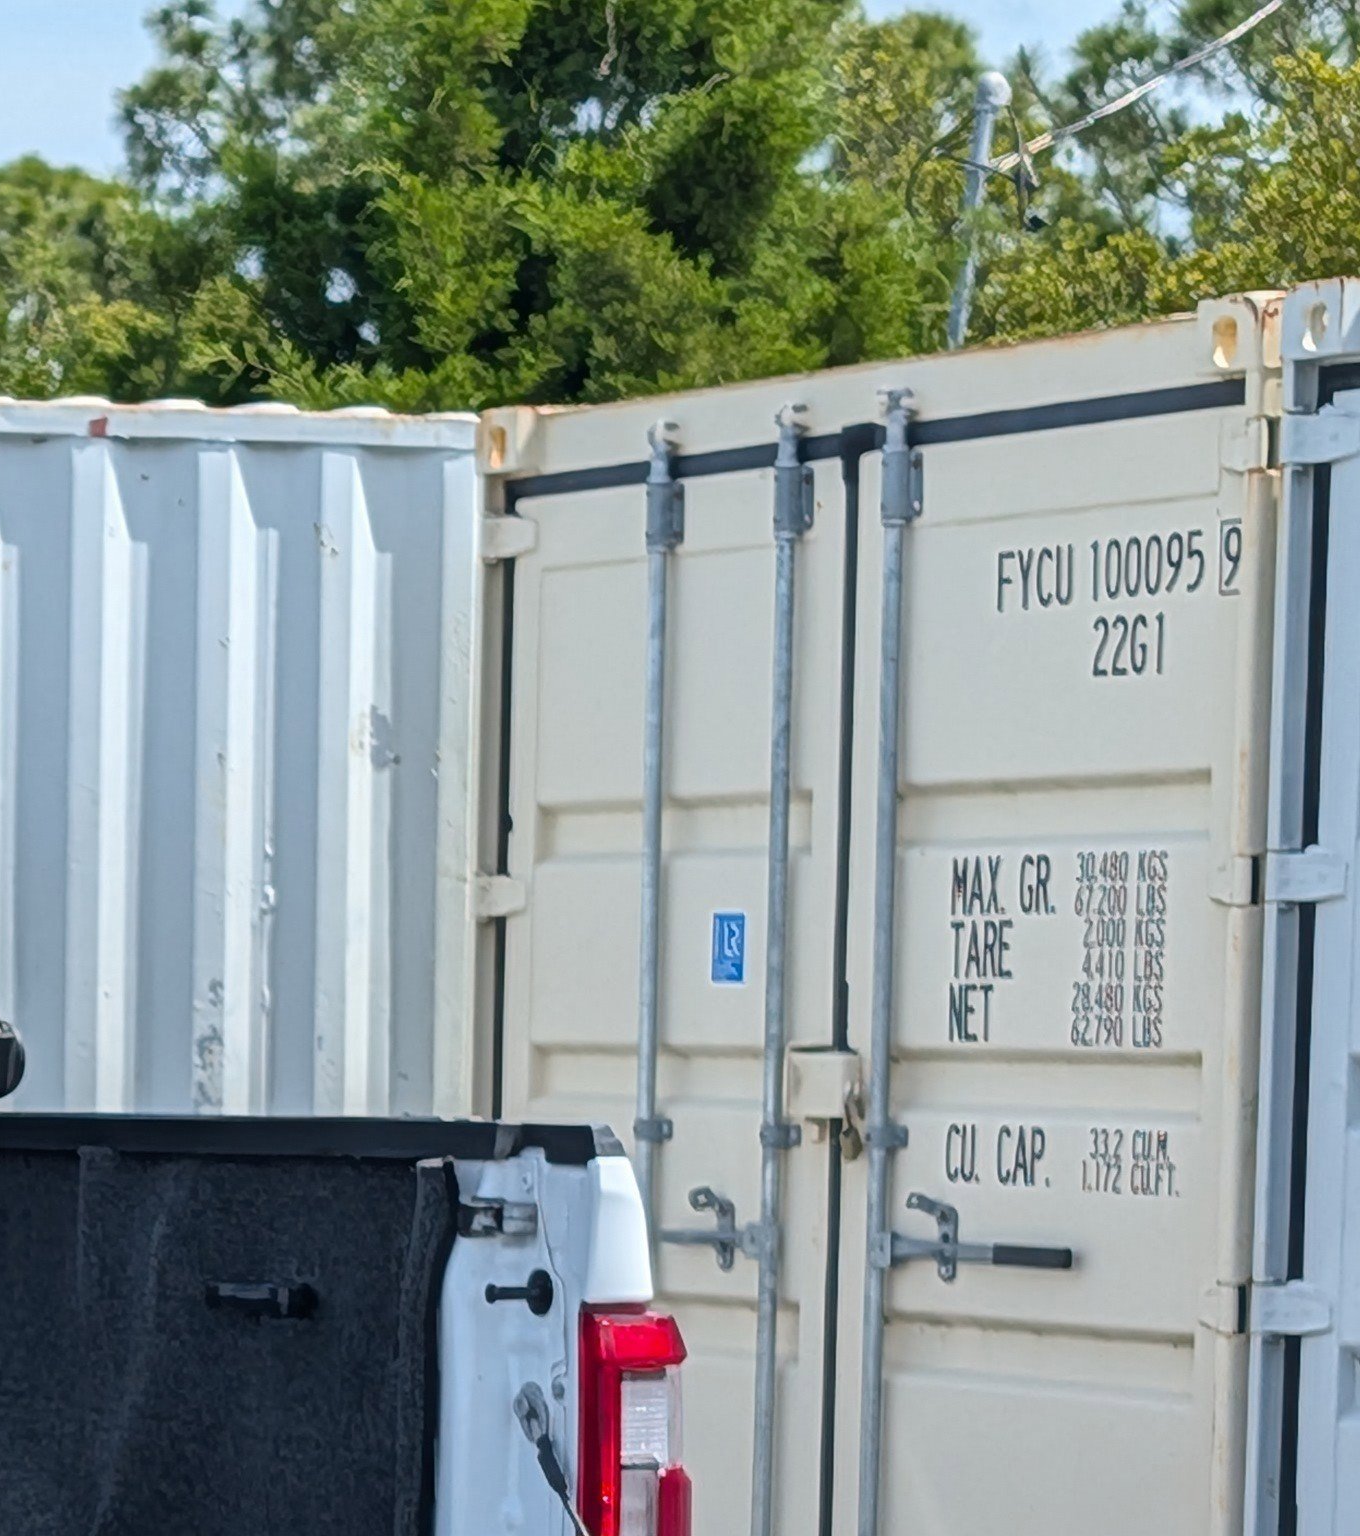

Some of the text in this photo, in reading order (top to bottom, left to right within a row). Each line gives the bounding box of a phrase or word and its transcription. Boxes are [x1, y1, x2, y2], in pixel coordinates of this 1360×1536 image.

[997, 526, 1243, 613] FYCU 100095 9
[1092, 611, 1165, 677] 22G1
[951, 853, 1057, 916] MAX. GR.
[1137, 849, 1168, 882] KGS
[1136, 884, 1167, 916] LBS
[950, 919, 1013, 979] TARE
[1135, 918, 1166, 948] KGS
[1134, 949, 1164, 981] LBS
[949, 983, 994, 1043] NET
[1133, 984, 1163, 1014] KGS
[1132, 1015, 1162, 1047] LBS
[946, 1122, 1051, 1187] CU. CAP.
